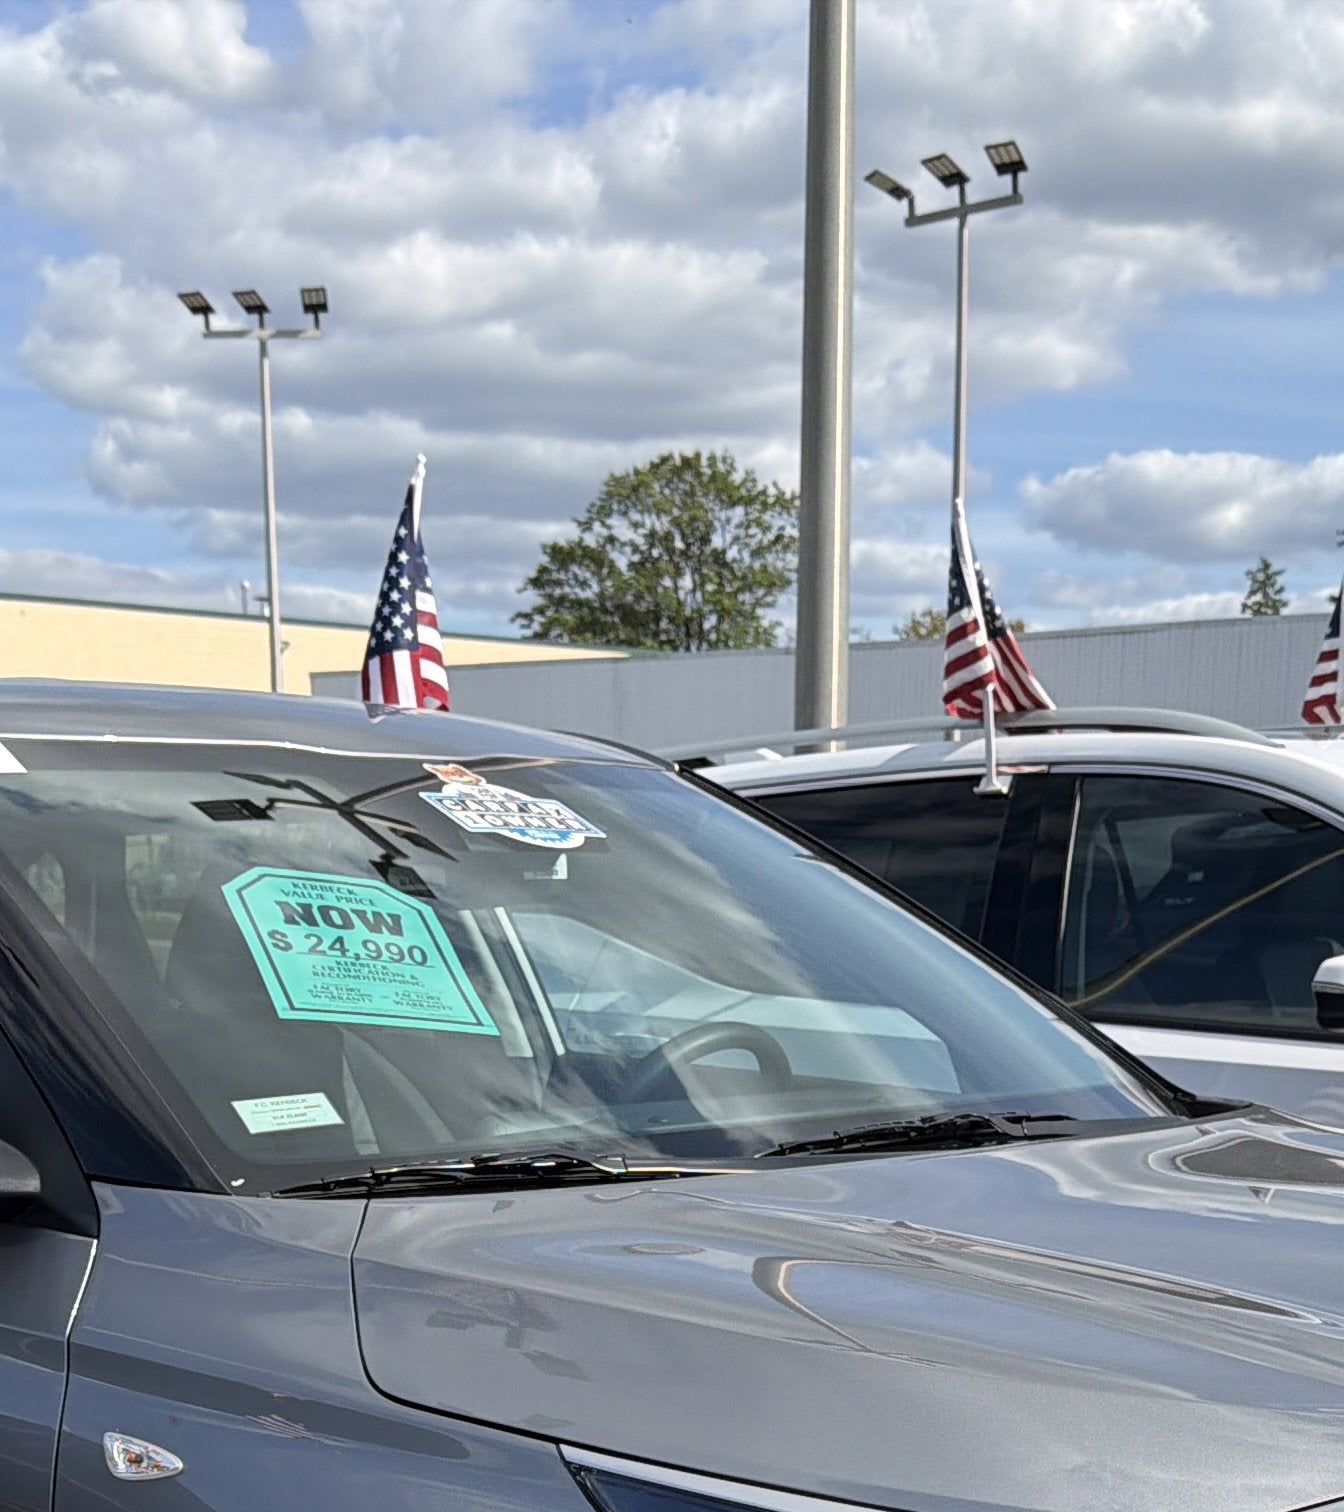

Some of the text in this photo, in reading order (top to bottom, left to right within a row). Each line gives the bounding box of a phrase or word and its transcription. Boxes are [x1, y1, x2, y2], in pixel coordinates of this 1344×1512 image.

[279, 888, 379, 908] VALUE PRICE
[290, 881, 358, 896] KERBECK
[273, 899, 406, 938] NOW
[266, 929, 429, 967] $ 24,990
